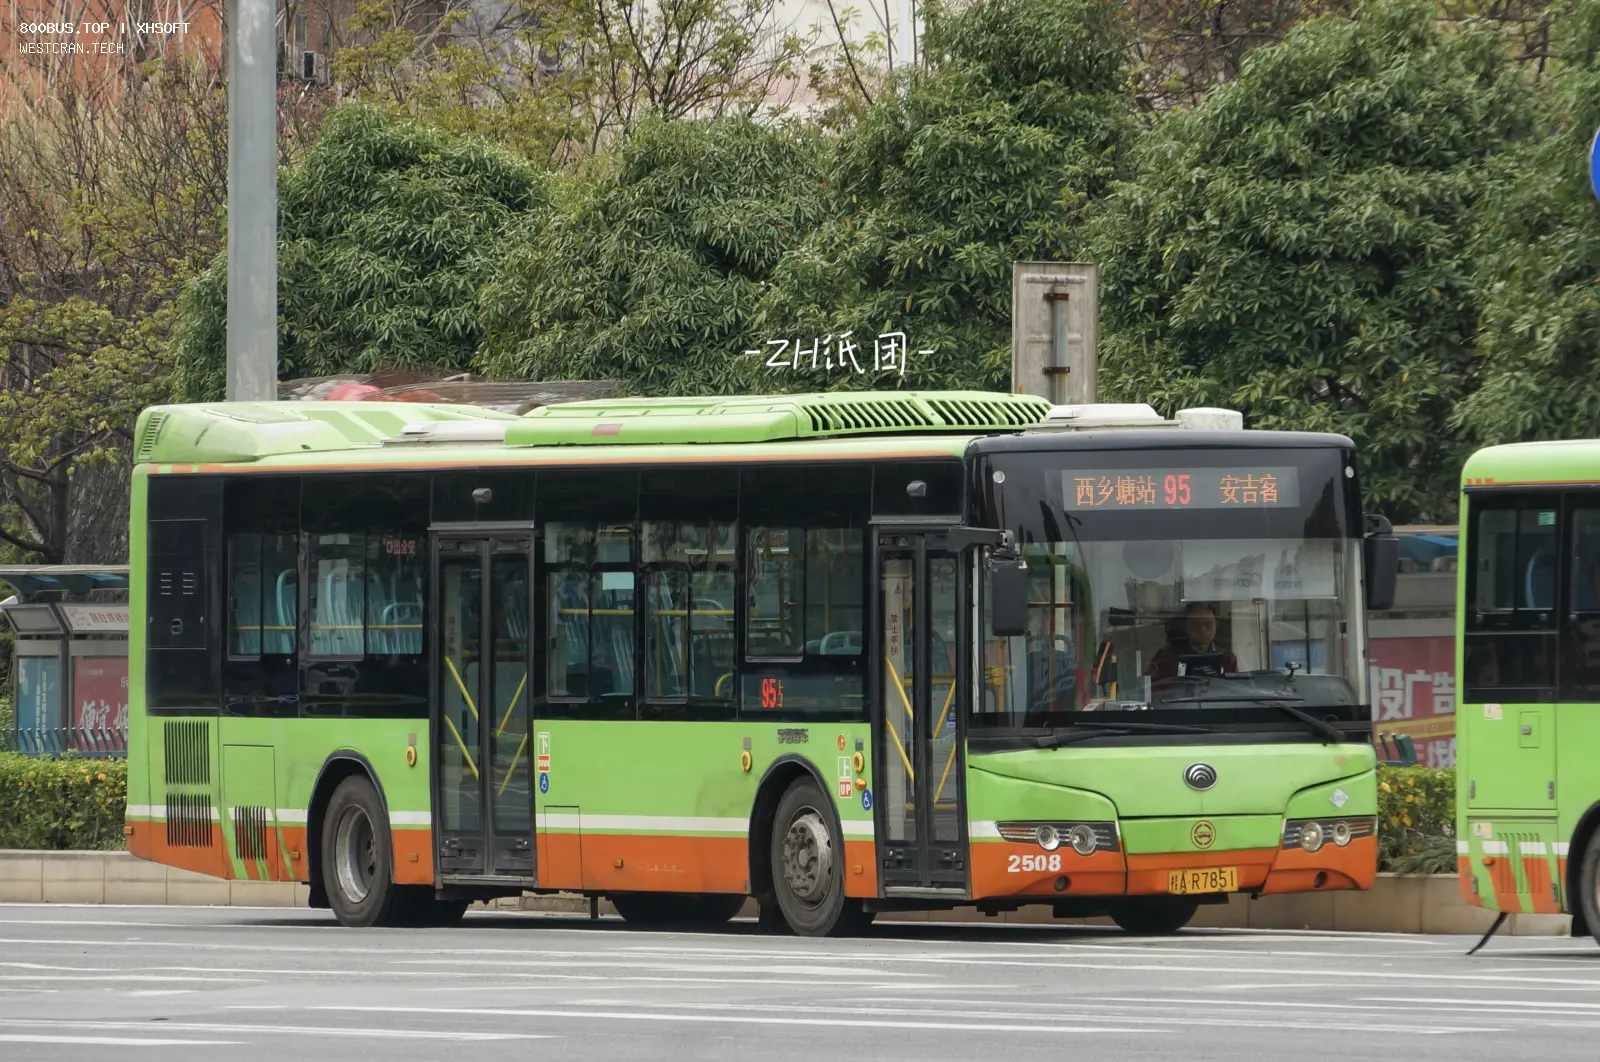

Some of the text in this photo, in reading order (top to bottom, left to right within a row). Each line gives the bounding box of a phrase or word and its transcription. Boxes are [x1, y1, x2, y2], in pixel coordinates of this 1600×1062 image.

[1074, 475, 1156, 506] 西乡塘站
[1164, 474, 1191, 505] 95
[761, 678, 777, 708] 95
[538, 733, 550, 754] 下
[839, 758, 851, 780] 上
[840, 782, 851, 797] UP
[1007, 855, 1061, 873] 2508
